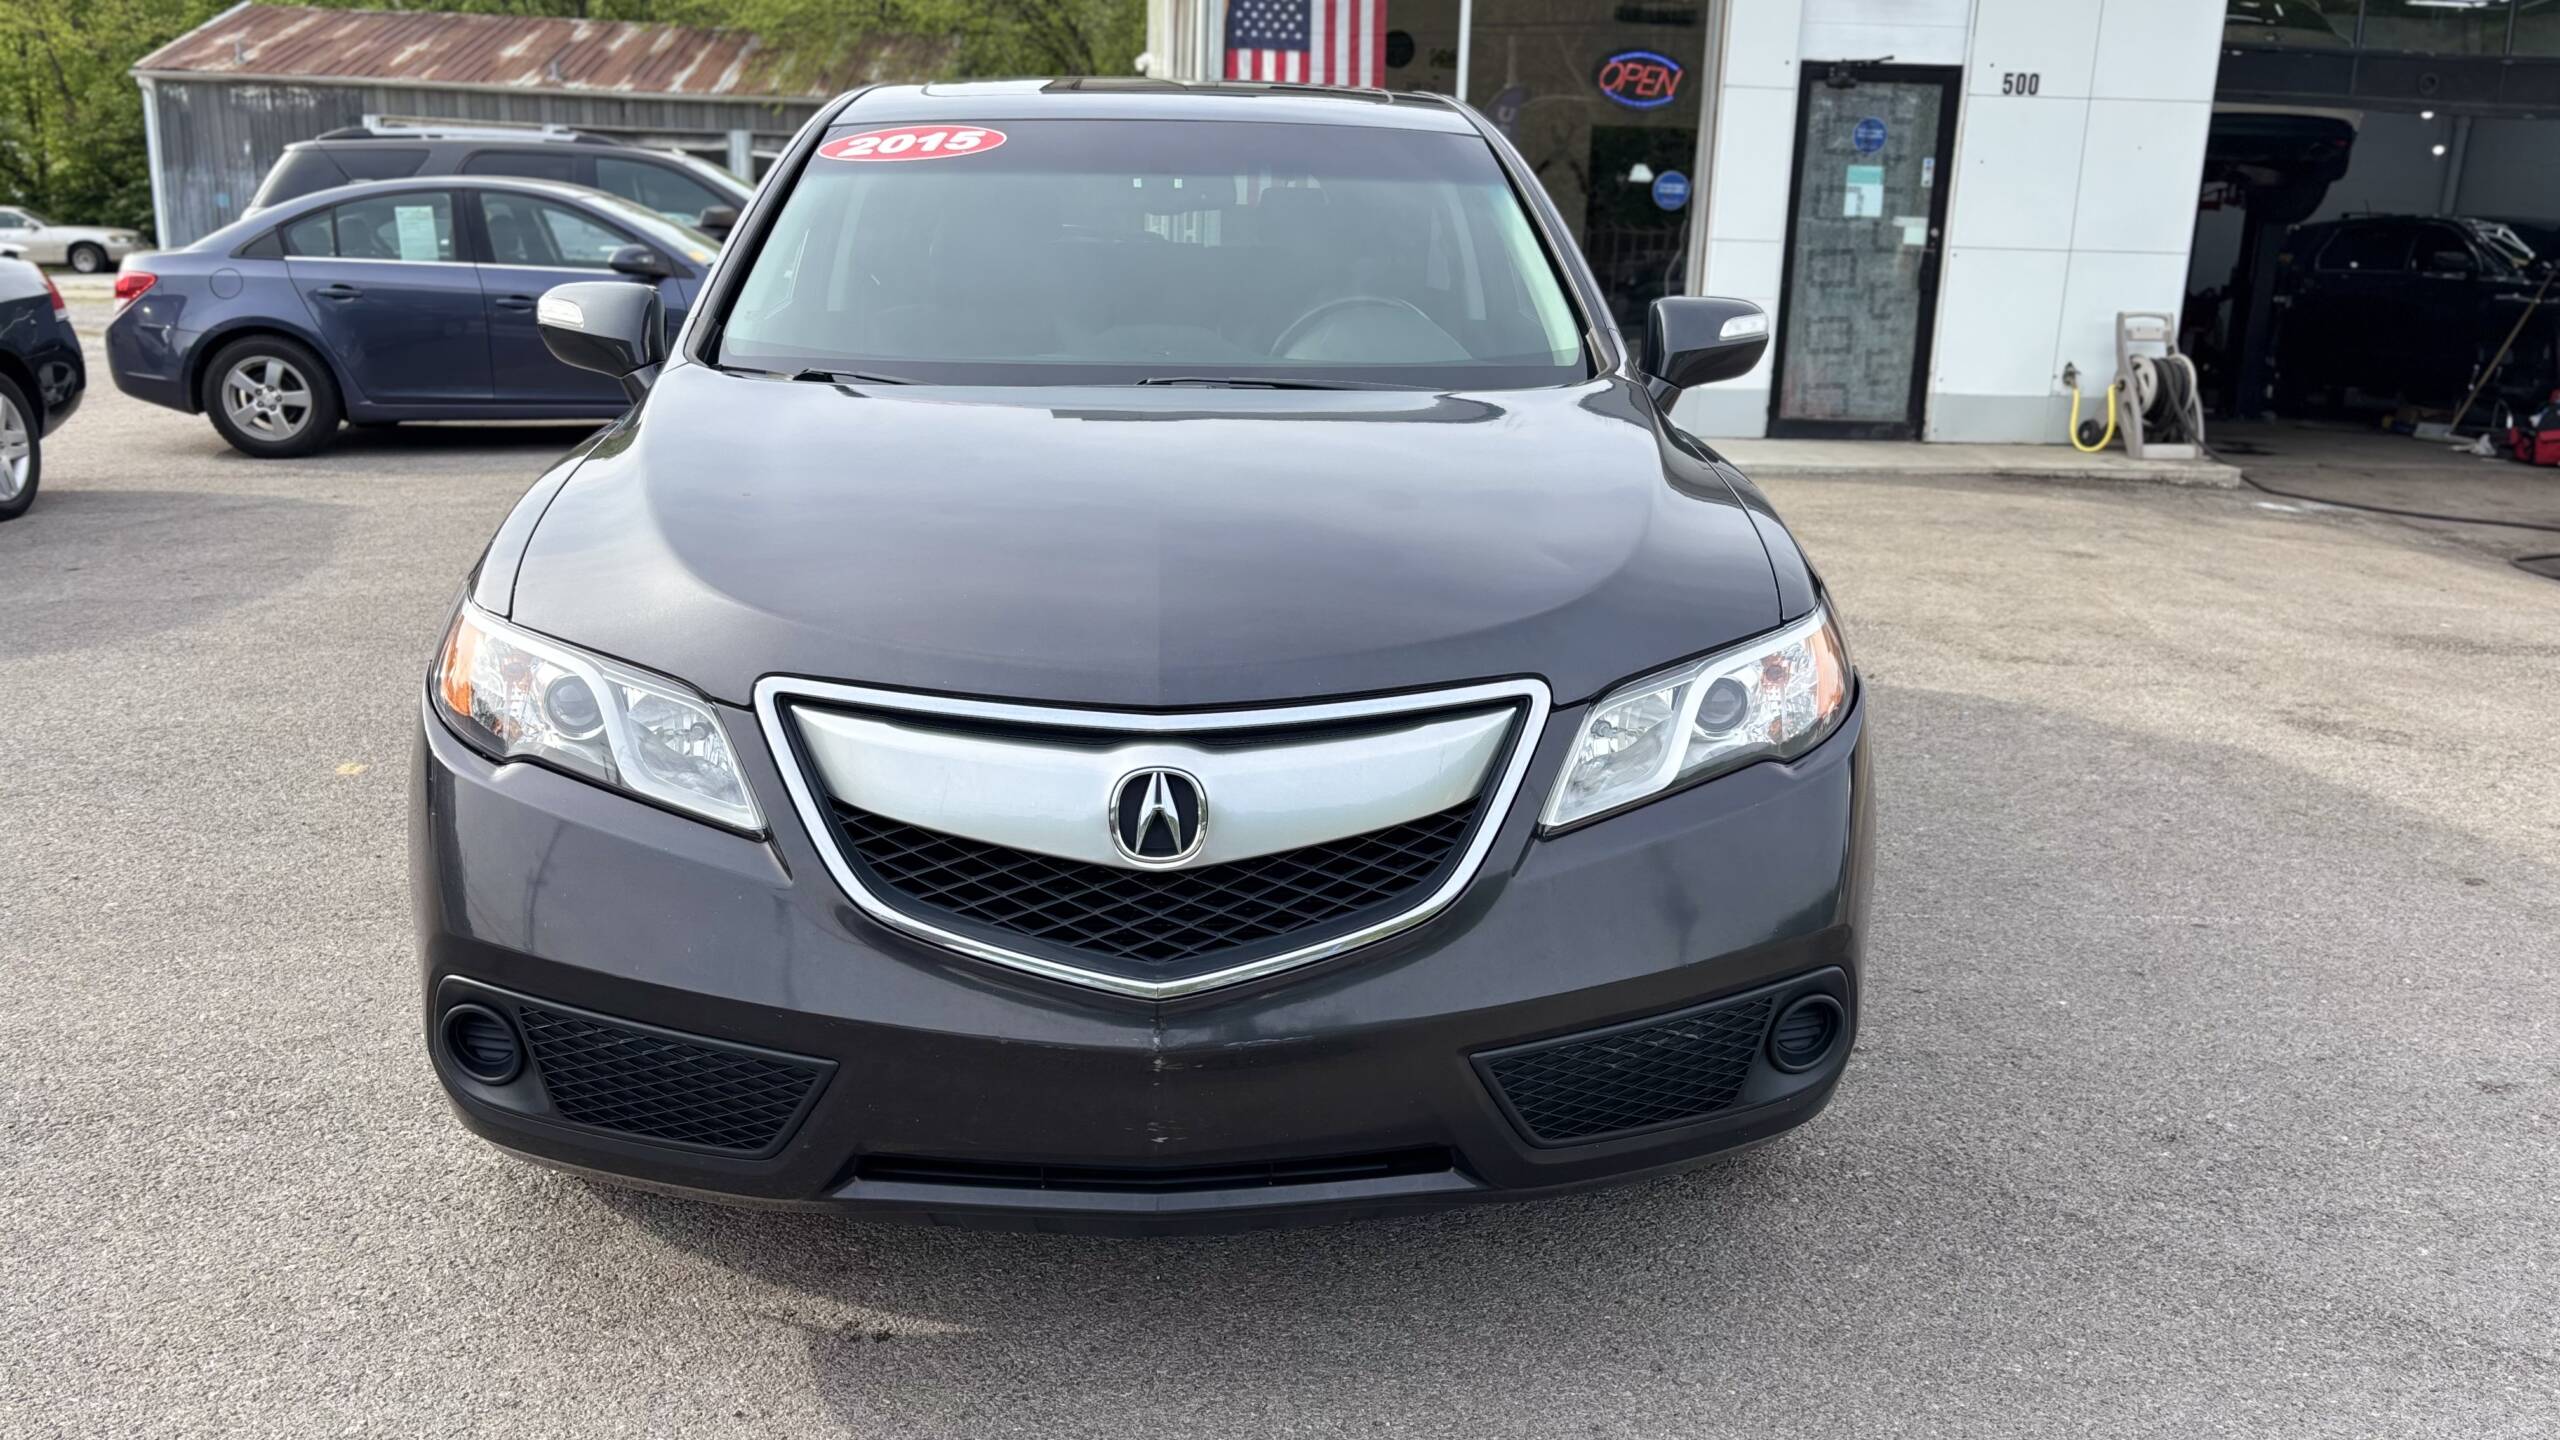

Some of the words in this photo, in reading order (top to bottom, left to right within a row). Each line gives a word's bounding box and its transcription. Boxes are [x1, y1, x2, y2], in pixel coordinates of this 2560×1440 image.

[1599, 62, 1684, 97] OPEN
[2002, 72, 2040, 96] 500
[836, 131, 987, 157] 2015
